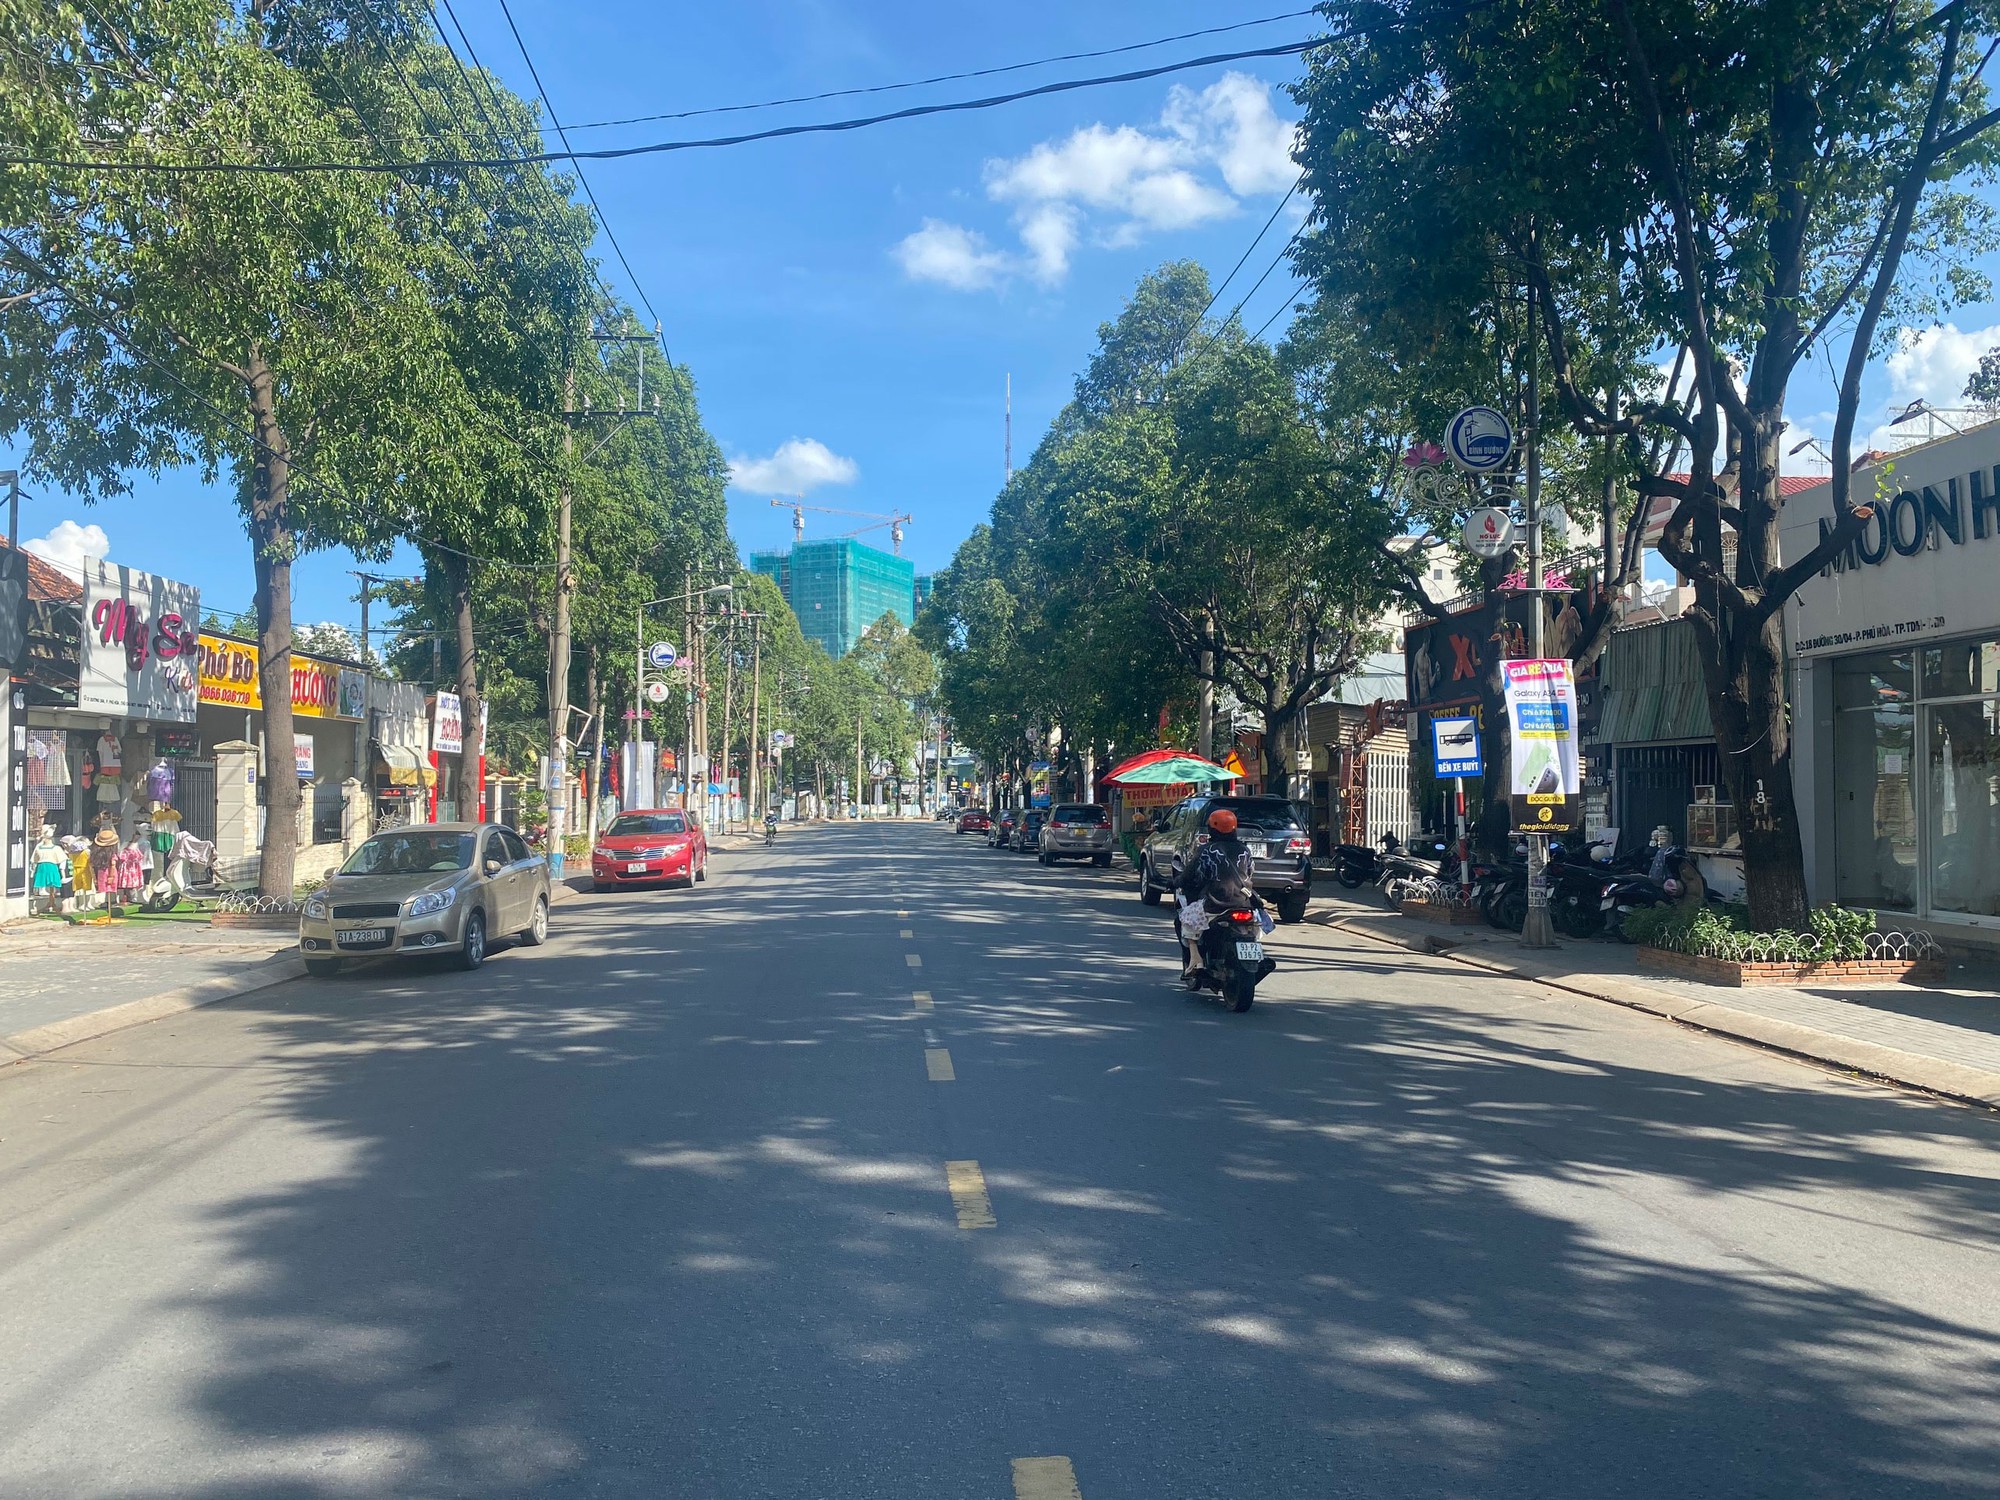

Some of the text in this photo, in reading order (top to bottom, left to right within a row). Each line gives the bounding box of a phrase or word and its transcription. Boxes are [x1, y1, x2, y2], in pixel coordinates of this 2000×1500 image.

[1514, 690, 1541, 699] Galaxy
[1438, 760, 1478, 773] BẾN XE BUÝT
[1125, 788, 1161, 800] THƠM
[1519, 823, 1569, 831] thegioididong
